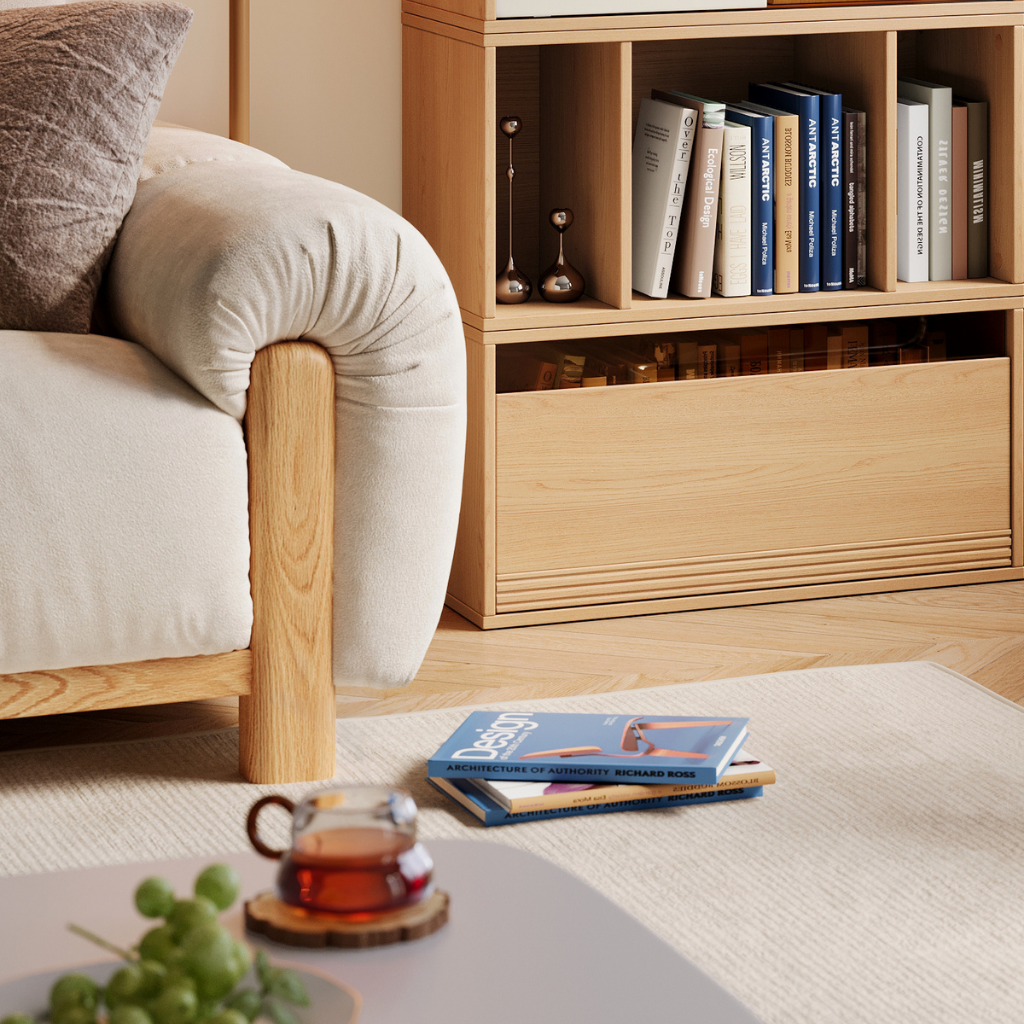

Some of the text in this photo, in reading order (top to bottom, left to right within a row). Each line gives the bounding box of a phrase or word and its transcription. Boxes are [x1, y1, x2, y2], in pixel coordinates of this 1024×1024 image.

[729, 144, 746, 180] WILLSON
[762, 138, 770, 202] ANTARCTIC
[808, 119, 816, 188] ANTARCTIC
[831, 118, 839, 187] ANTARCTIC
[664, 117, 694, 252] Over the Top
[700, 148, 718, 228] Ecological Design
[730, 205, 746, 224] LAID
[730, 229, 746, 250] HAVE
[730, 262, 747, 284] EGGS
[450, 712, 539, 760] Design
[446, 764, 528, 773] ARCHITECTURE
[530, 766, 546, 774] OF
[548, 768, 610, 776] AUTHORITY
[615, 769, 665, 778] RICHARD
[504, 806, 583, 819] ARCHITECTURE
[604, 798, 662, 809] AUTHORITY
[667, 791, 715, 802] RICHARD
[718, 788, 745, 796] ROSS
